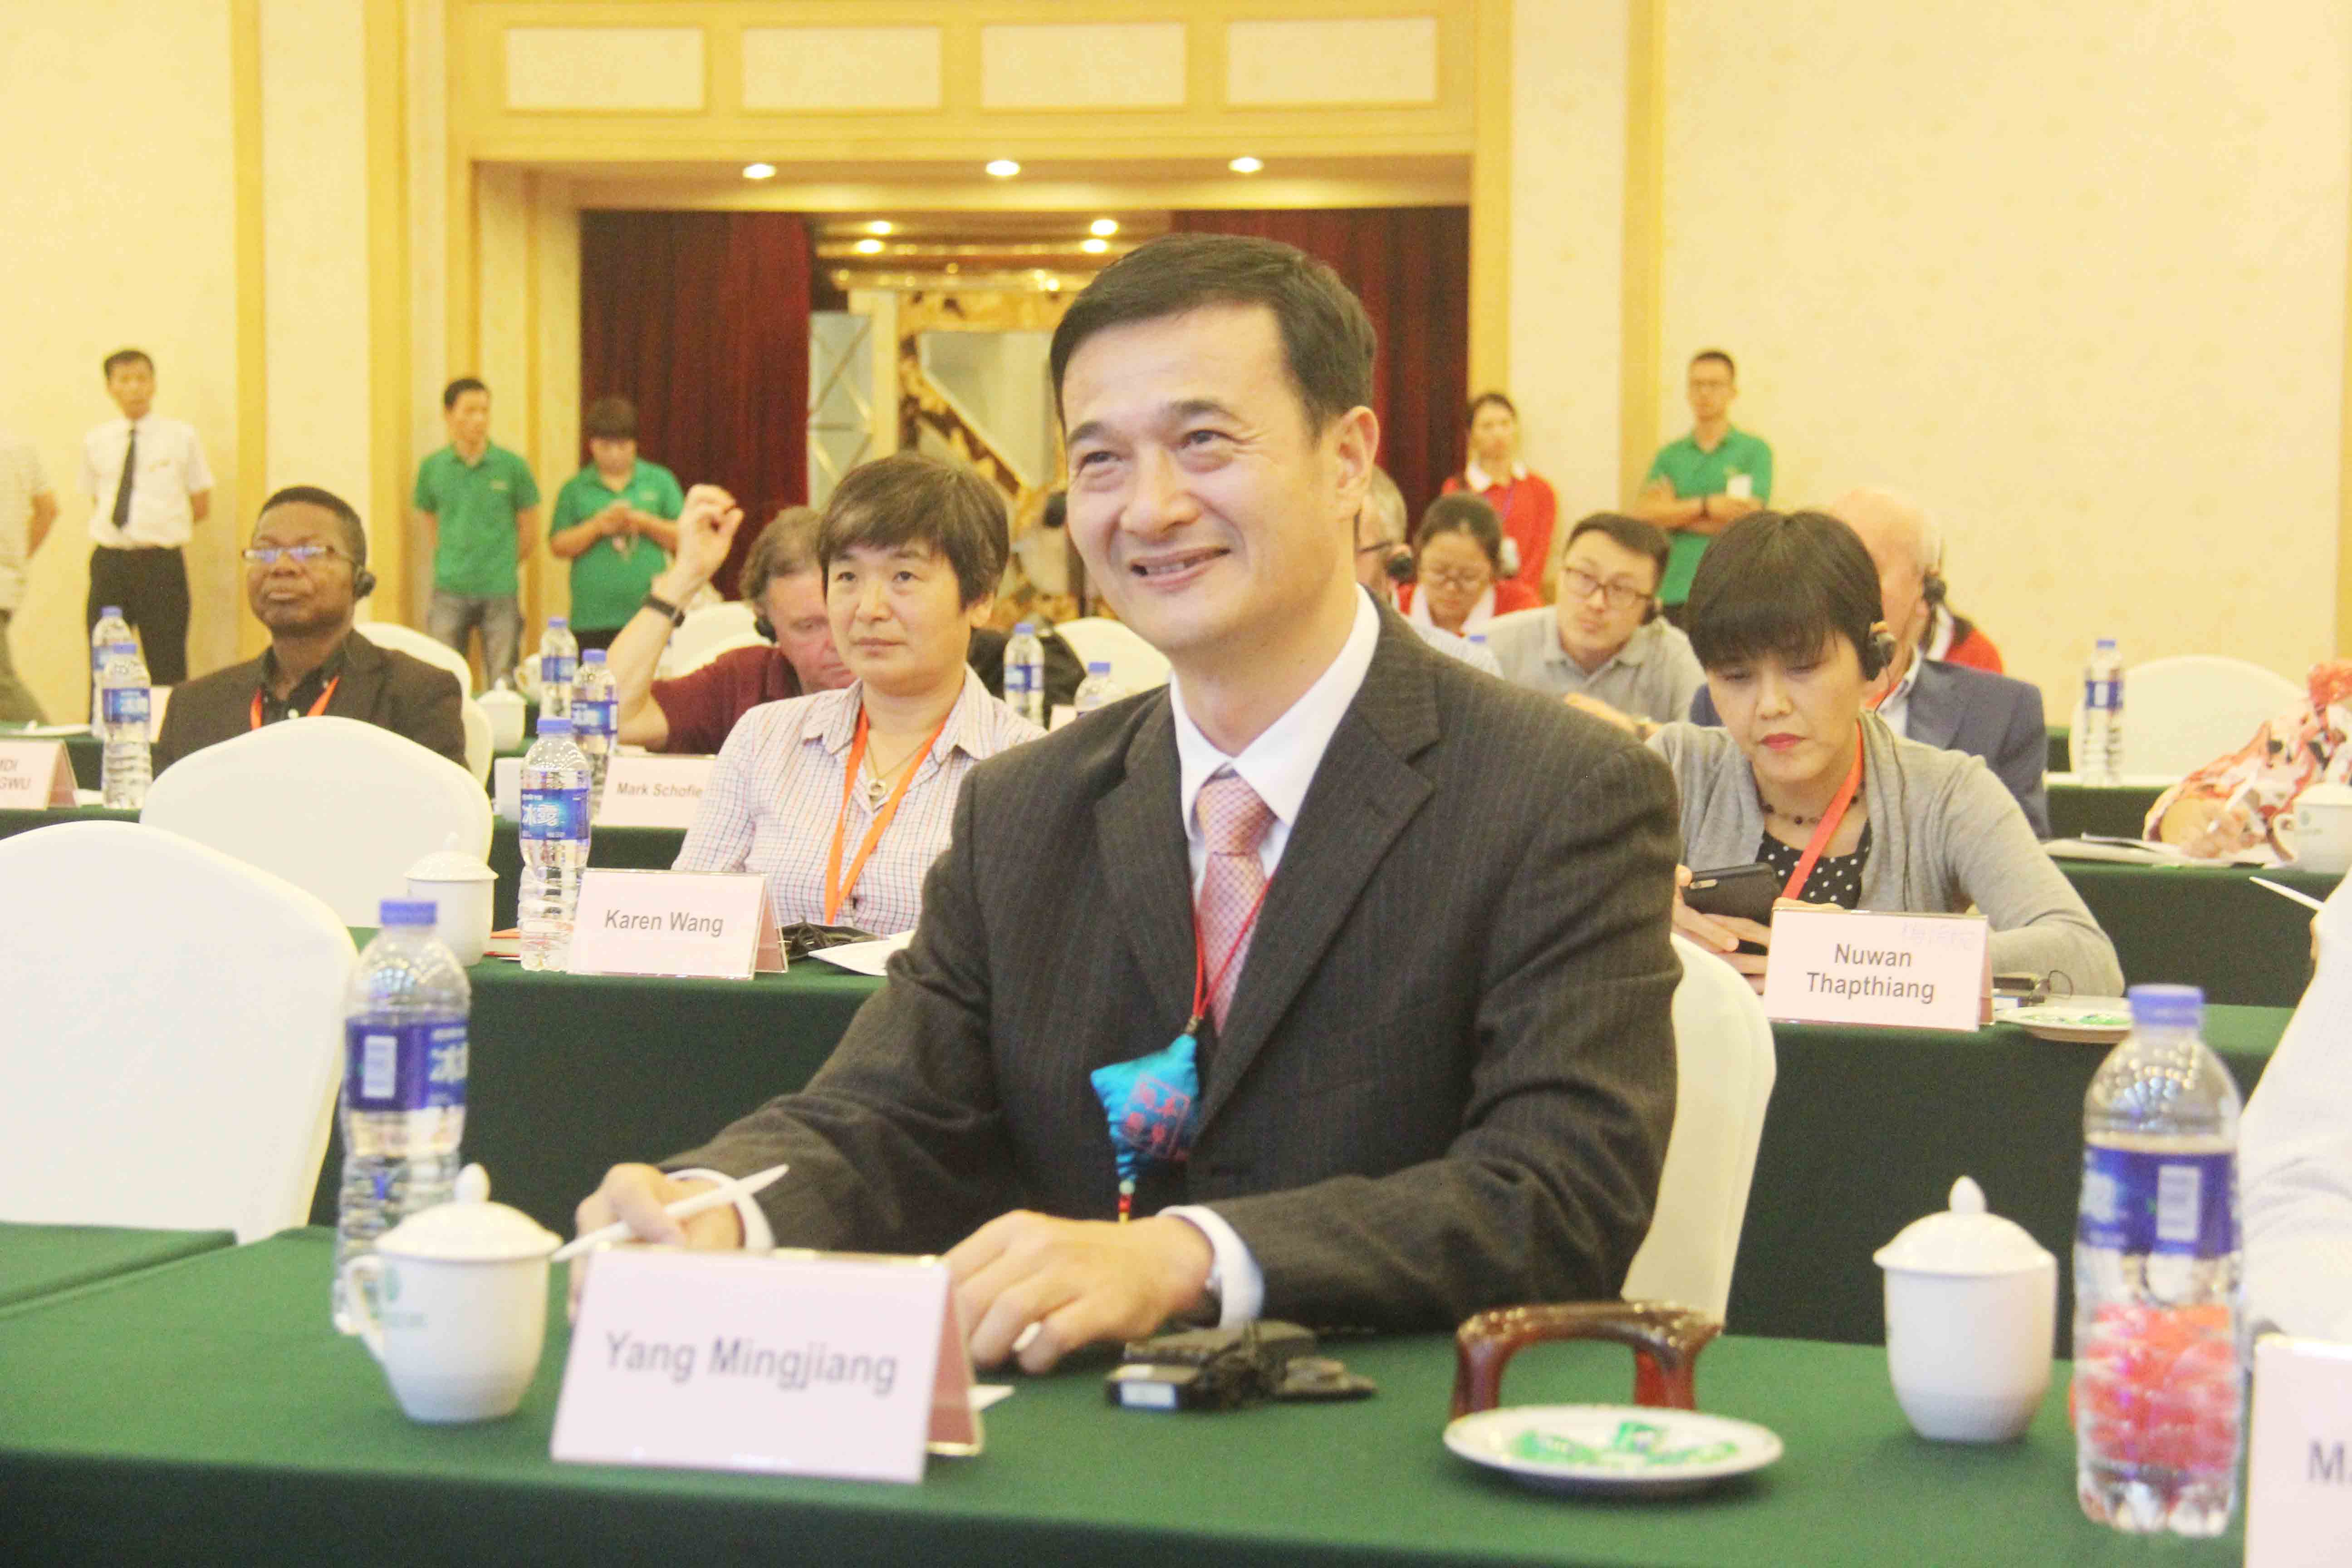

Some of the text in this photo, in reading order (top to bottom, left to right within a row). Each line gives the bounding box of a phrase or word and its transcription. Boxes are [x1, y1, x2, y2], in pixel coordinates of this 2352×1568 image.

[617, 781, 649, 795] Mark
[604, 909, 725, 938] Karen Wang
[1834, 943, 1912, 967] Nuwan
[1806, 971, 1935, 1004] Thapthiang
[604, 1329, 900, 1399] Yang Mingjiang
[2308, 1440, 2352, 1484] M
